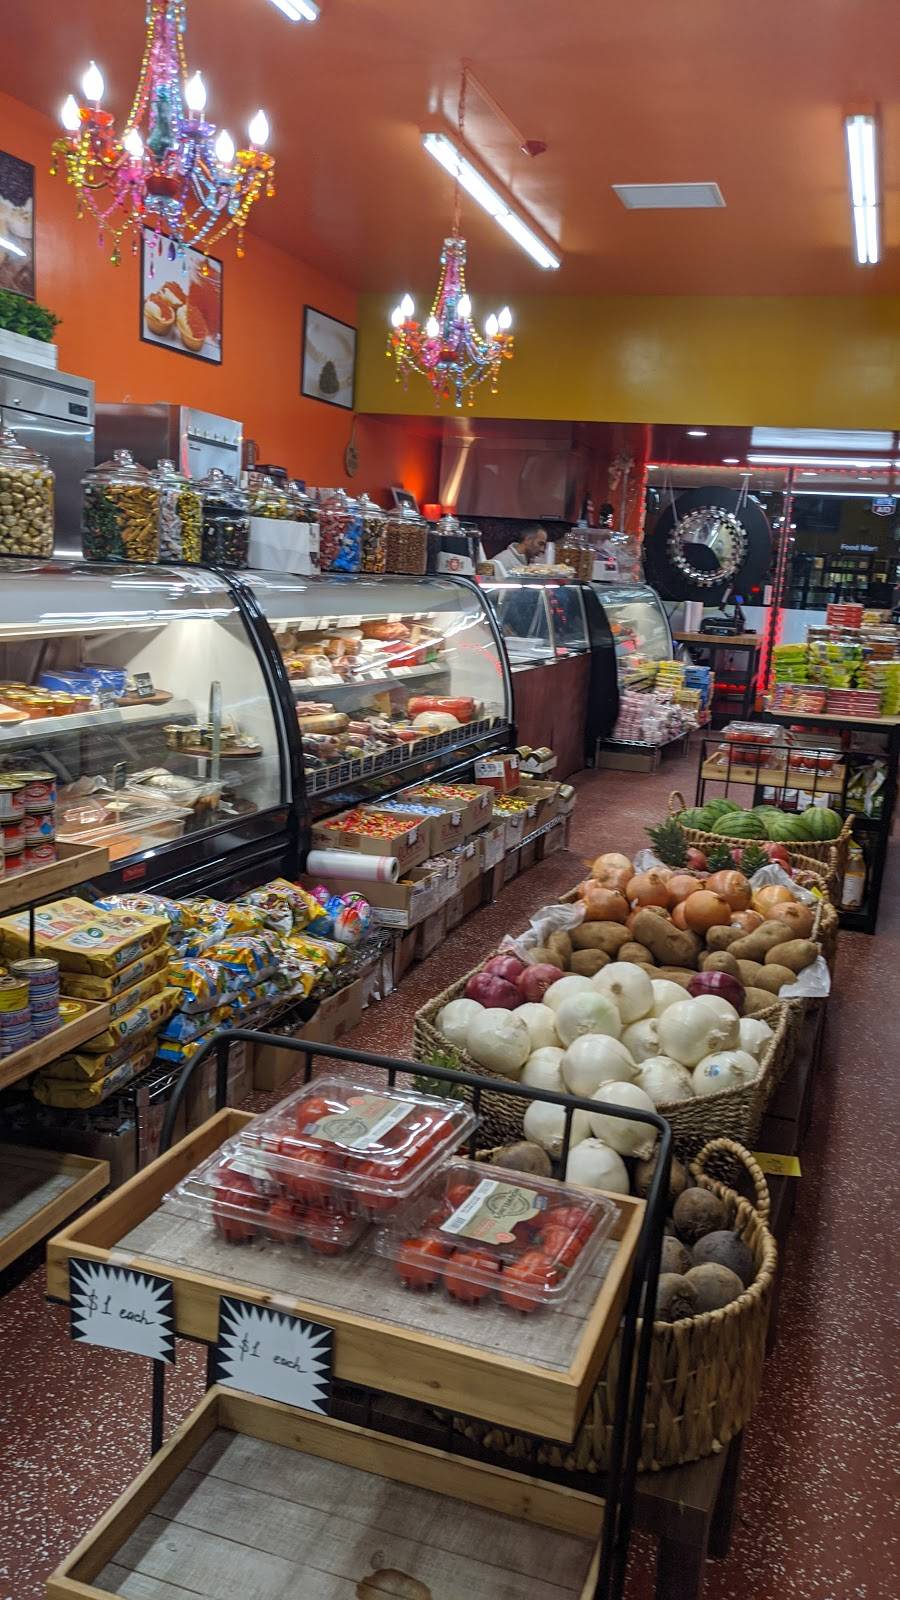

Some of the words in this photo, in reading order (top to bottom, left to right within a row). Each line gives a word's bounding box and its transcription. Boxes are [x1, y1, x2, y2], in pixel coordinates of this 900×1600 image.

[840, 543, 860, 551] Food
[86, 1289, 112, 1318] $1
[119, 1308, 156, 1325] each
[239, 1332, 261, 1362] $1
[272, 1355, 308, 1373] each
